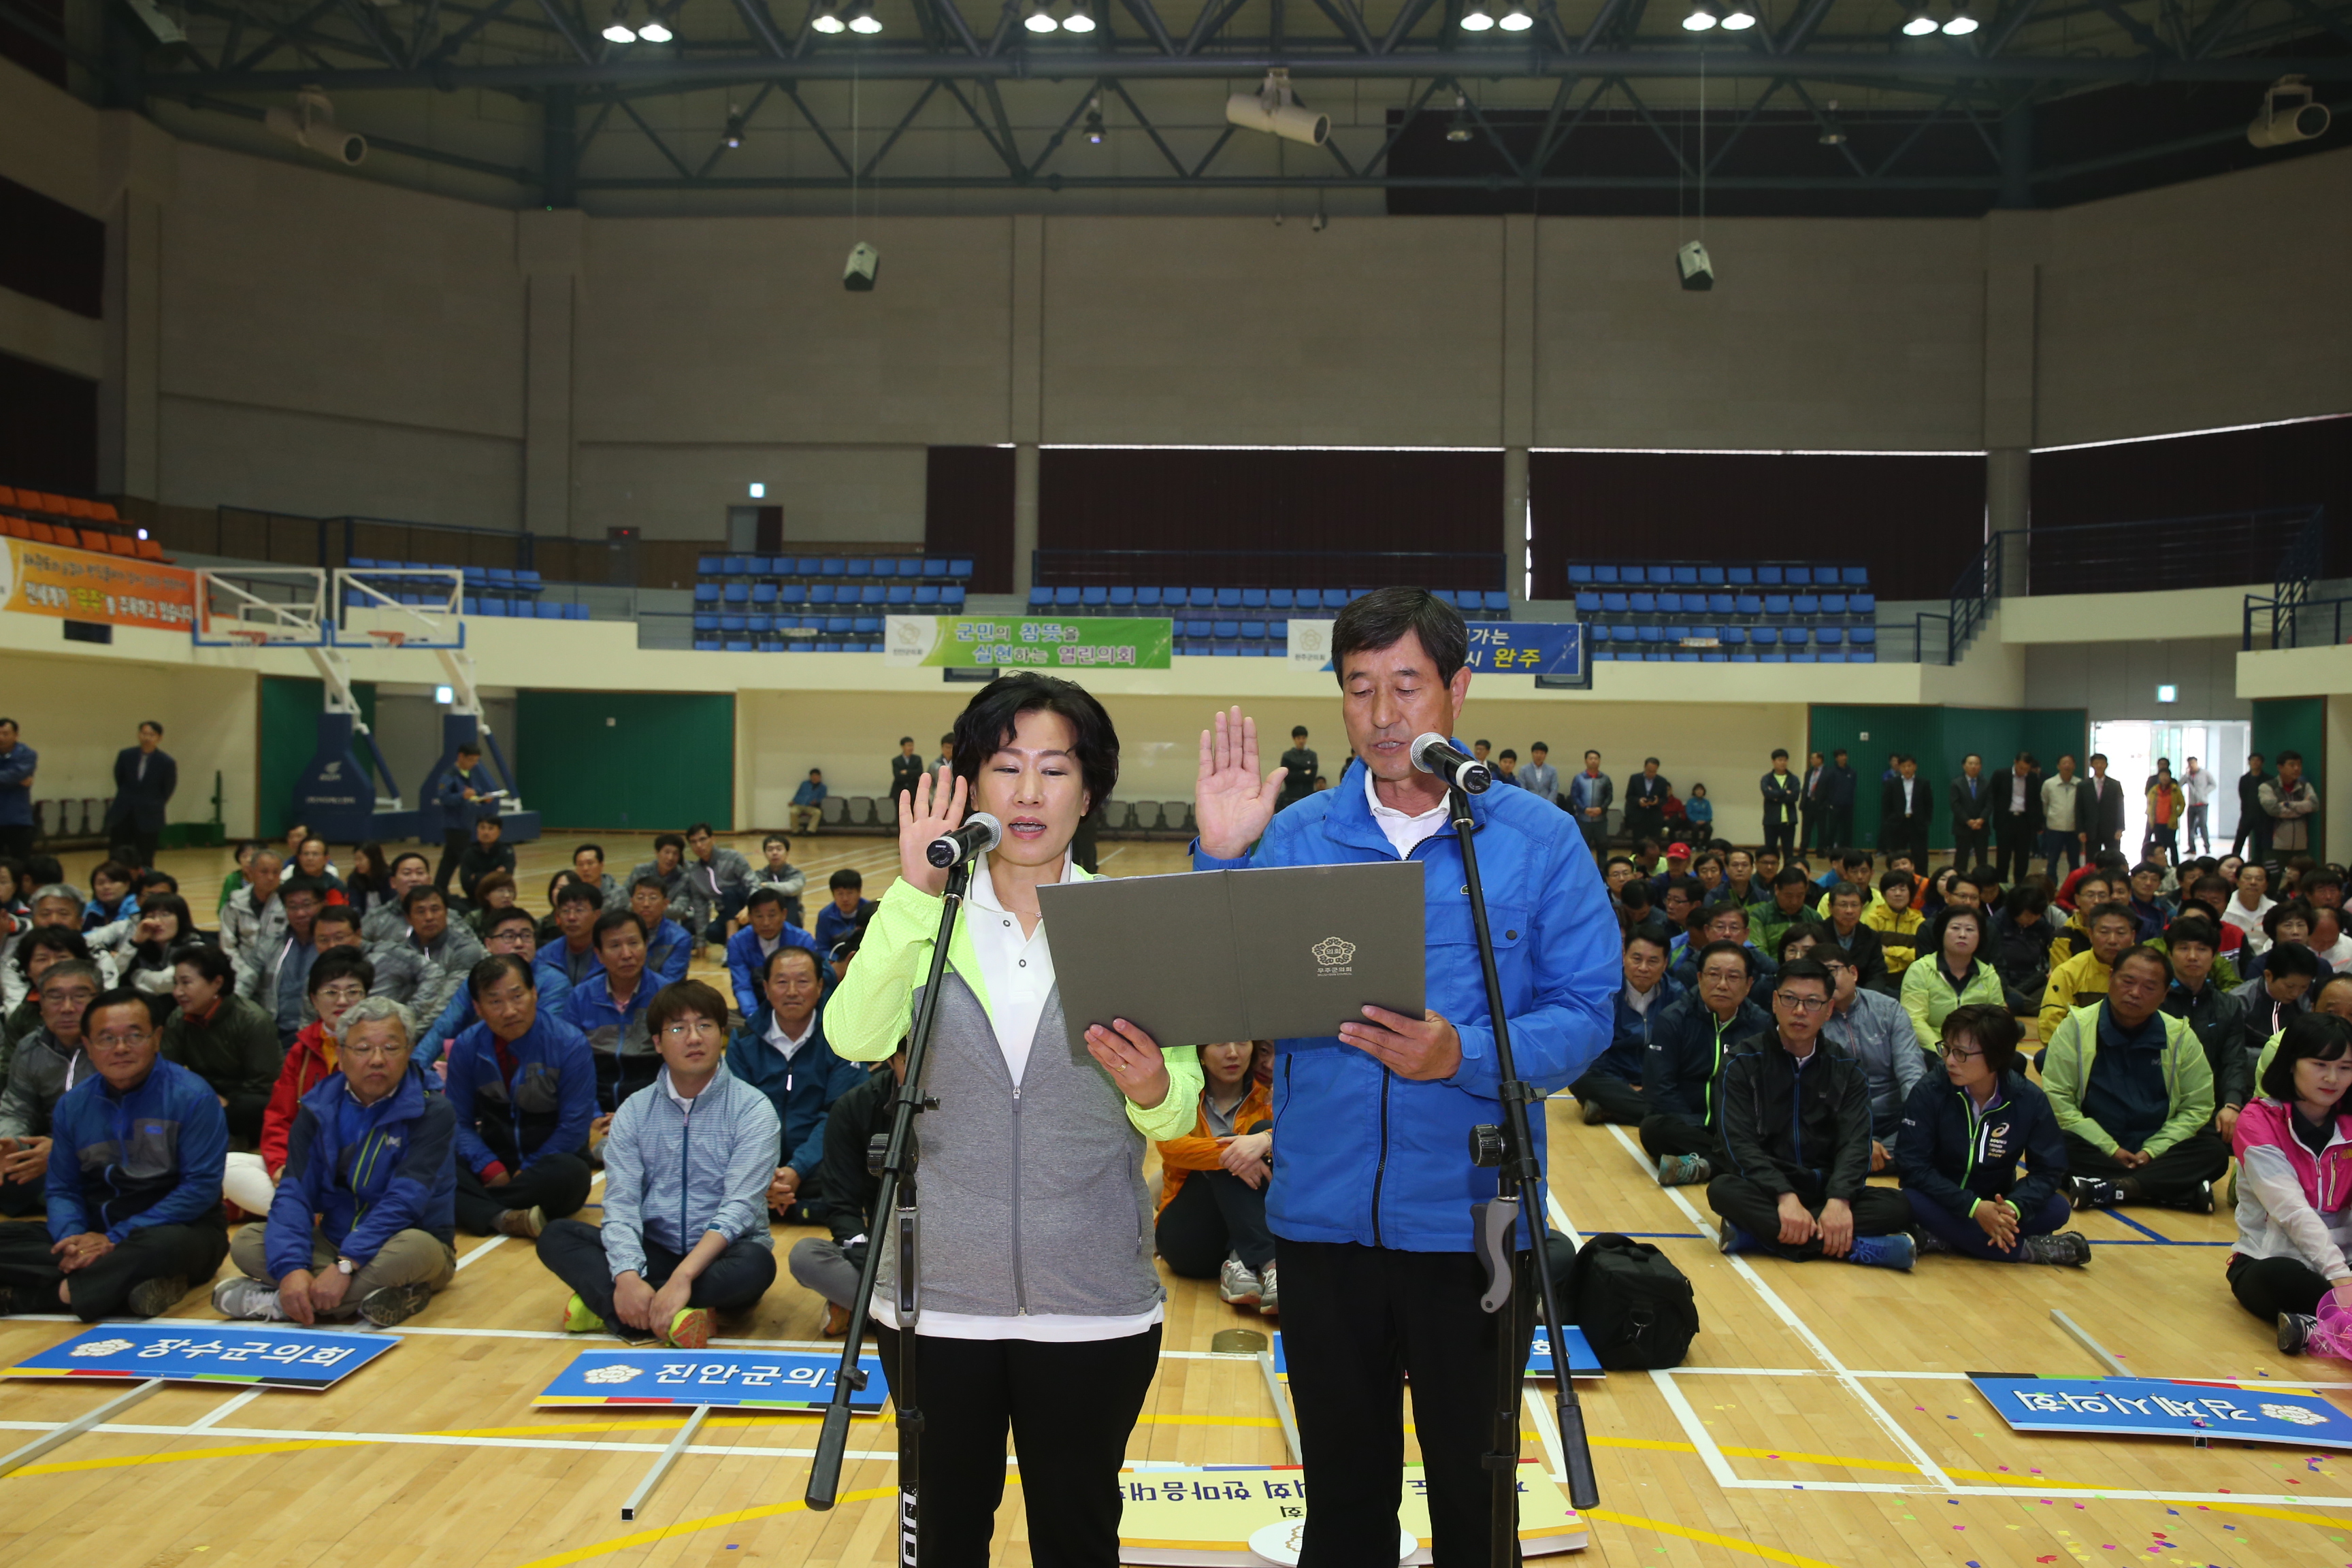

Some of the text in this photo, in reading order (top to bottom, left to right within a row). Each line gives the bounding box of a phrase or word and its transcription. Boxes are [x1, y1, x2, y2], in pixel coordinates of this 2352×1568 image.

[955, 622, 1079, 642] 군민의 참뜻을
[1466, 628, 1509, 645] 가는
[973, 645, 1136, 665] 실현하는 열린의회
[1493, 648, 1541, 668] 완주
[137, 1338, 356, 1367] 장수군의회
[655, 1363, 870, 1388] 진안군의
[2011, 1390, 2258, 1422] 김제시의회
